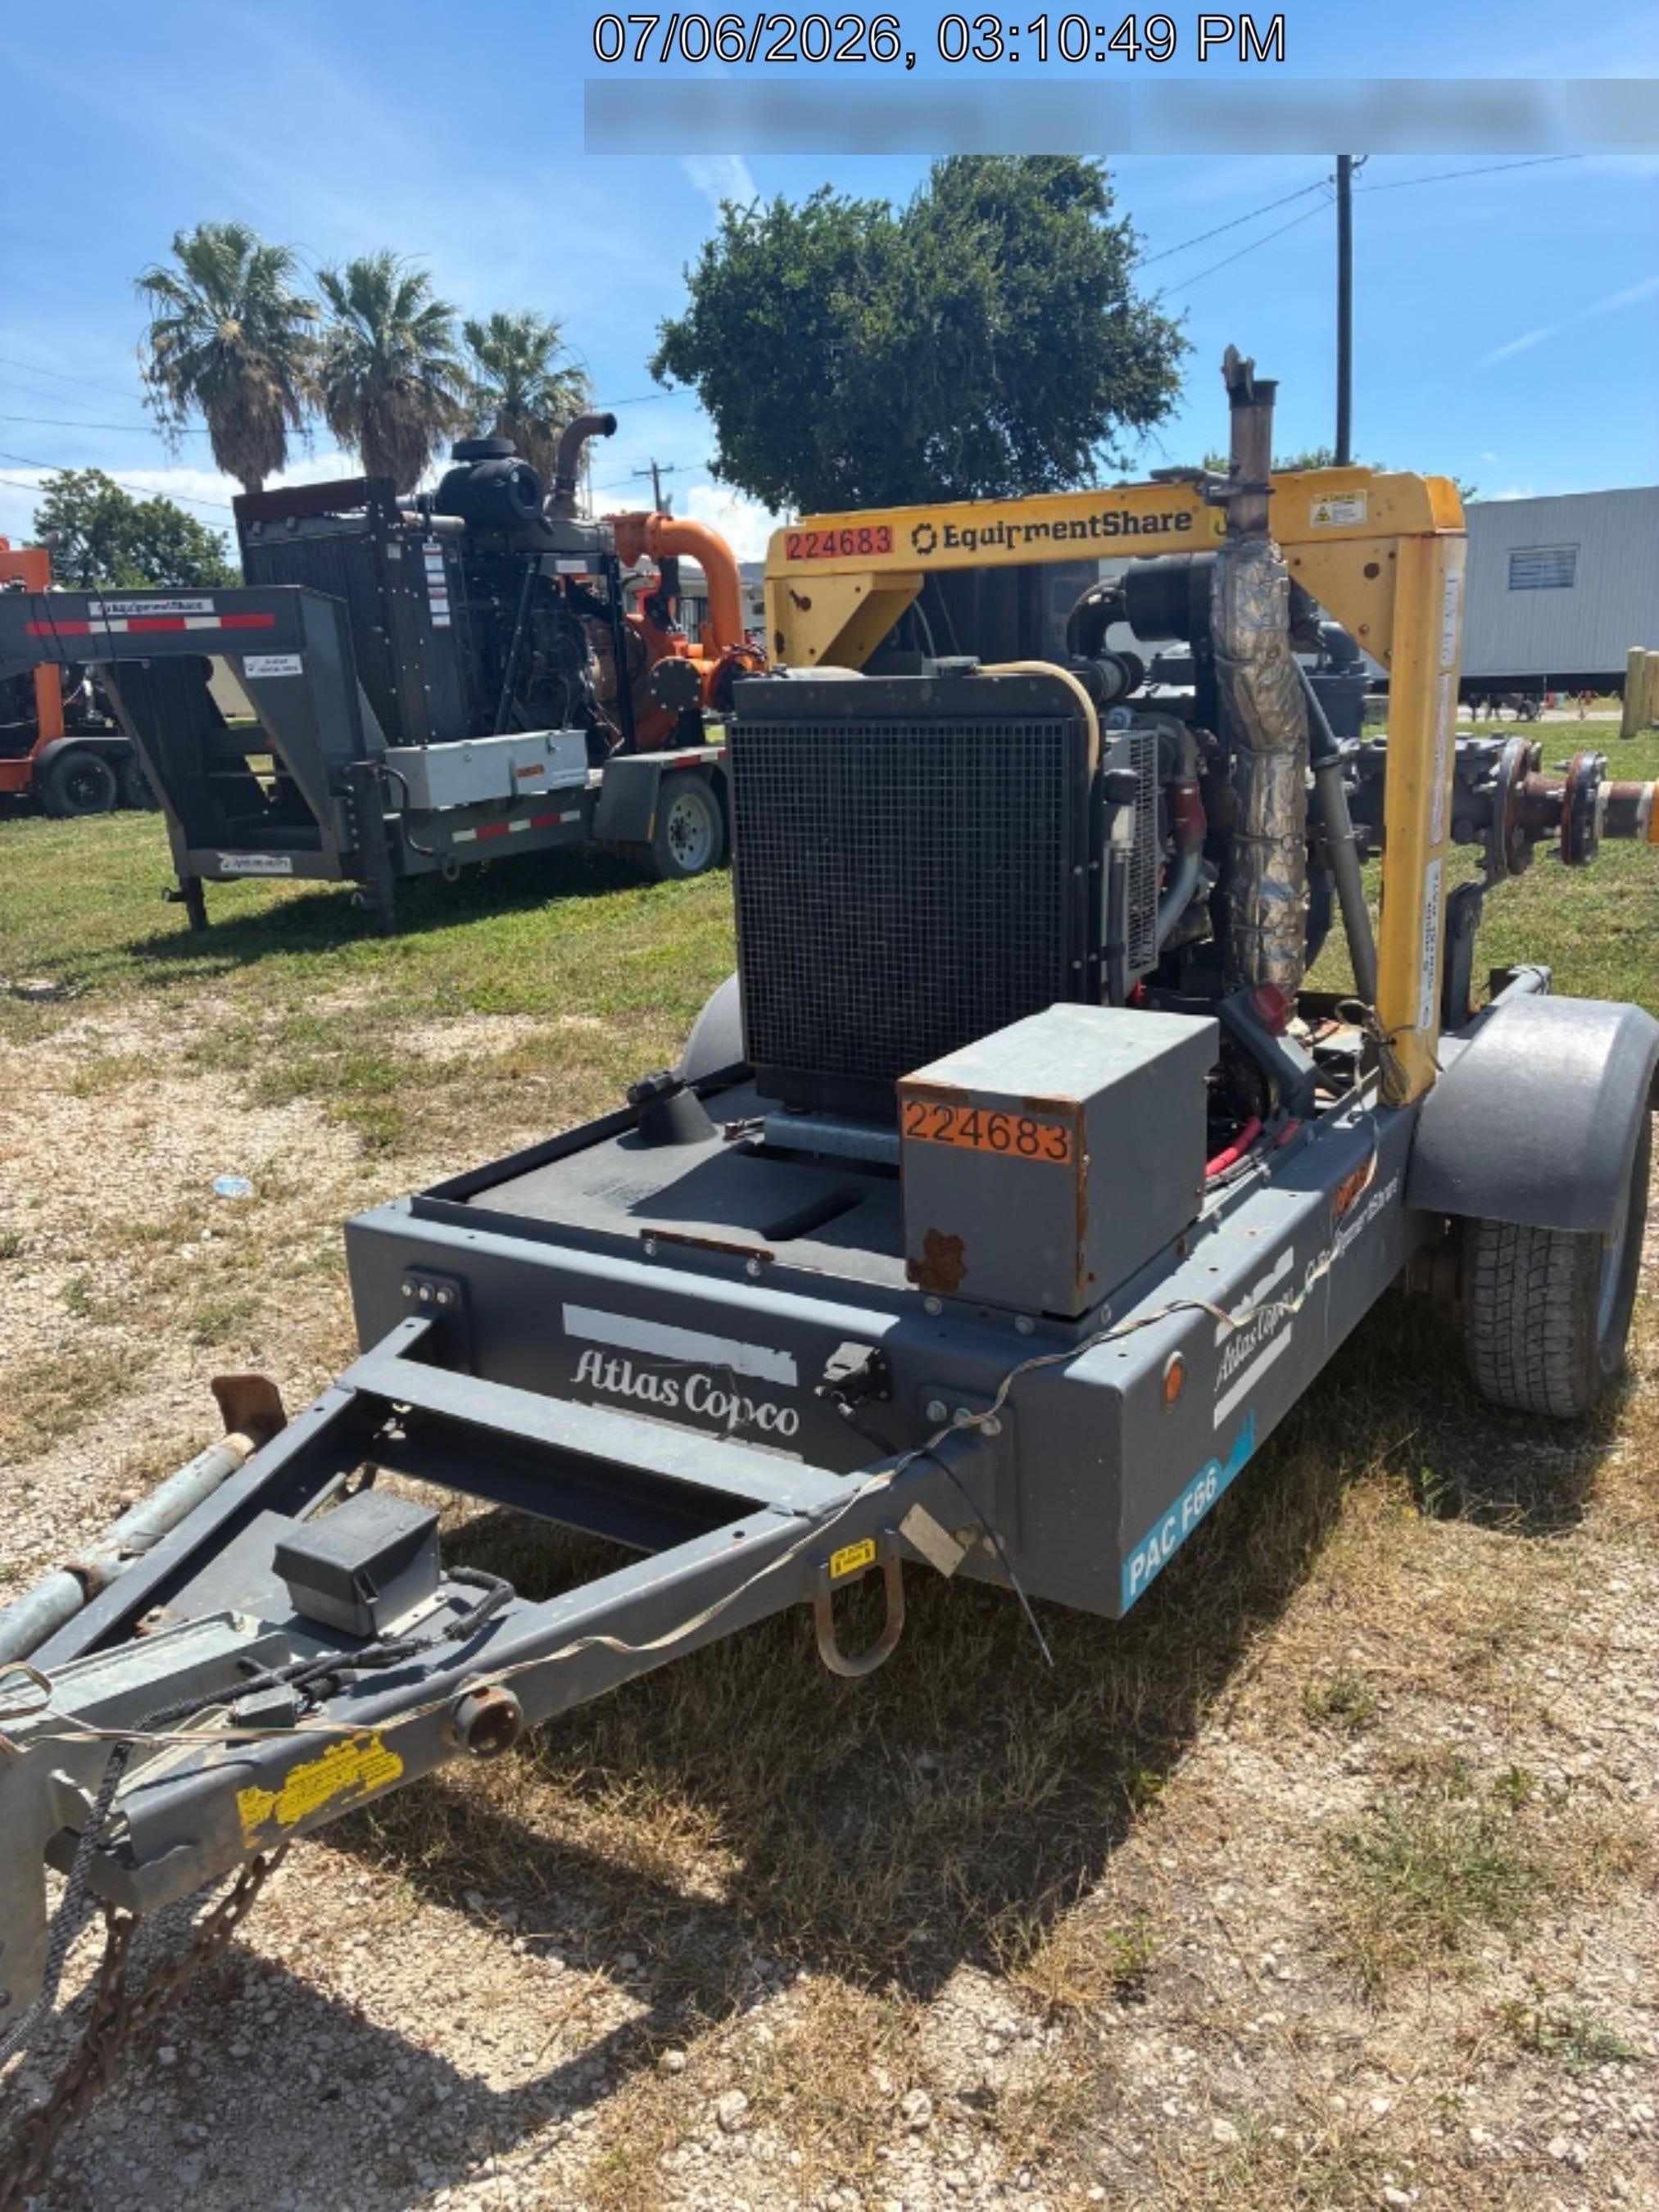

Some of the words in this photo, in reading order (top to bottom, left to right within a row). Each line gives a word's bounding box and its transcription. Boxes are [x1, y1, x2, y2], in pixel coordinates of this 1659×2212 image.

[788, 525, 891, 560] 224683
[905, 1101, 1068, 1160] 224683
[570, 1349, 679, 1407] Atlas
[684, 1373, 800, 1436] Copco
[1130, 1516, 1176, 1596] PAC
